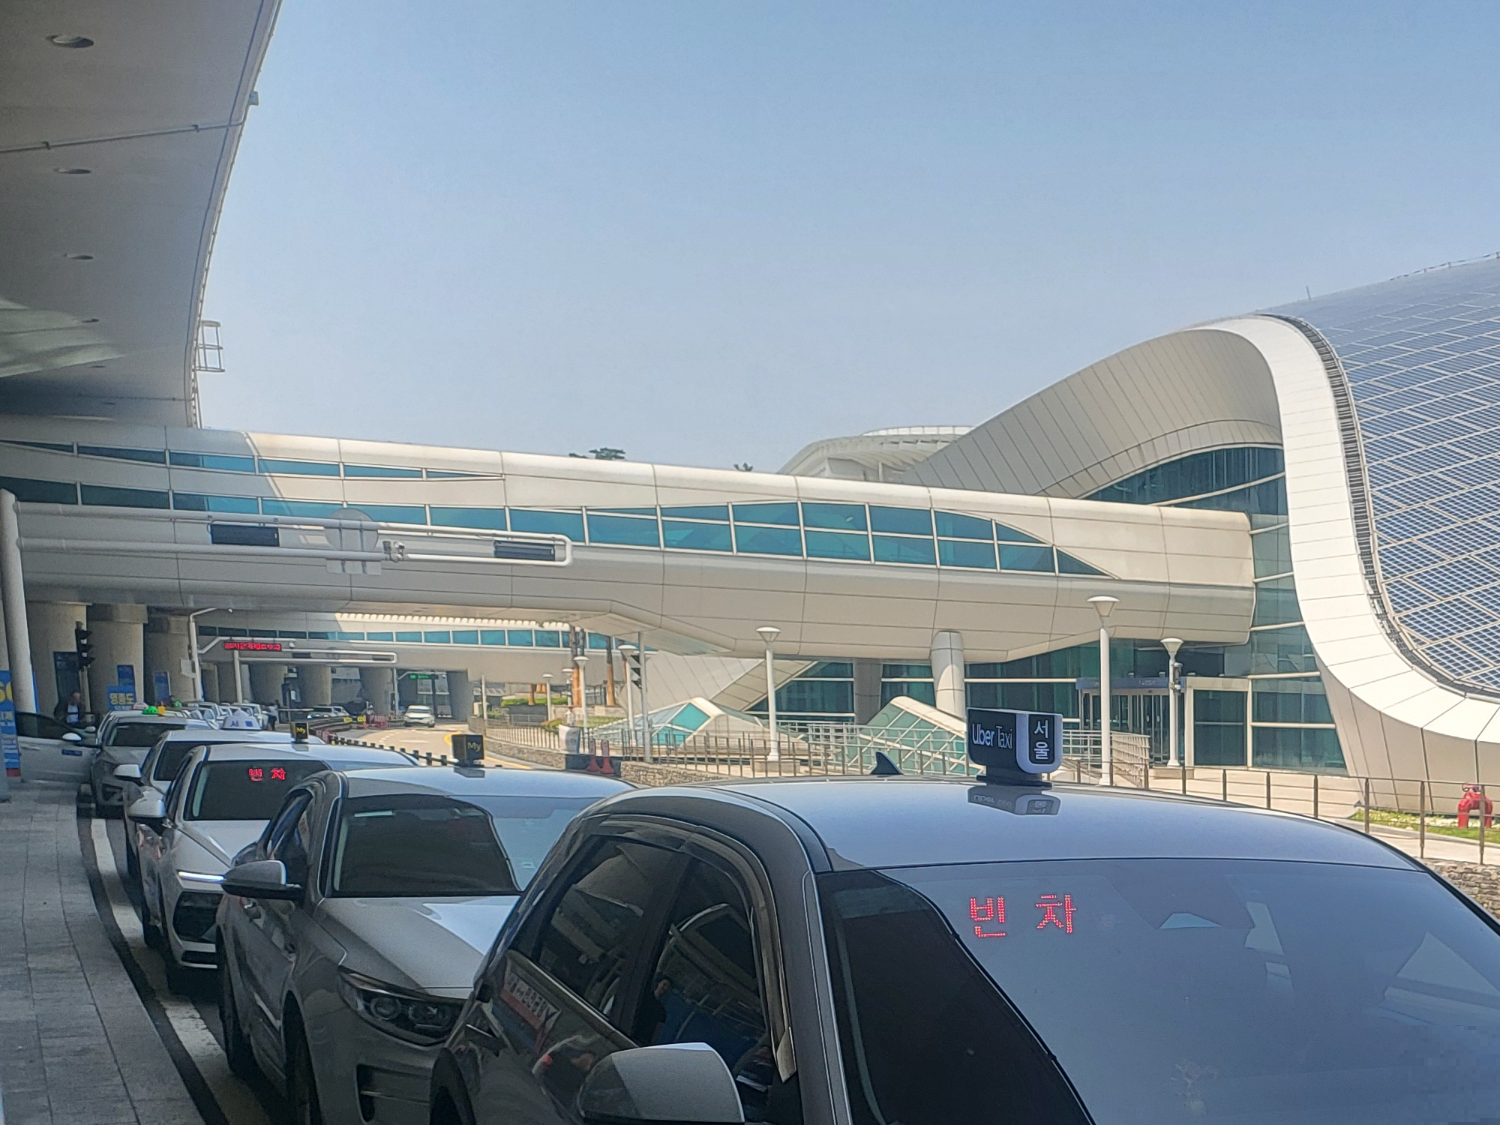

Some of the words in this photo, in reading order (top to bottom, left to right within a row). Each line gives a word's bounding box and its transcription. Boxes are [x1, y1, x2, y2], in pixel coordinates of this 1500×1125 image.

[467, 741, 482, 753] My
[972, 723, 996, 747] Uber
[996, 725, 1013, 749] Taxi
[1033, 719, 1050, 760] 서울
